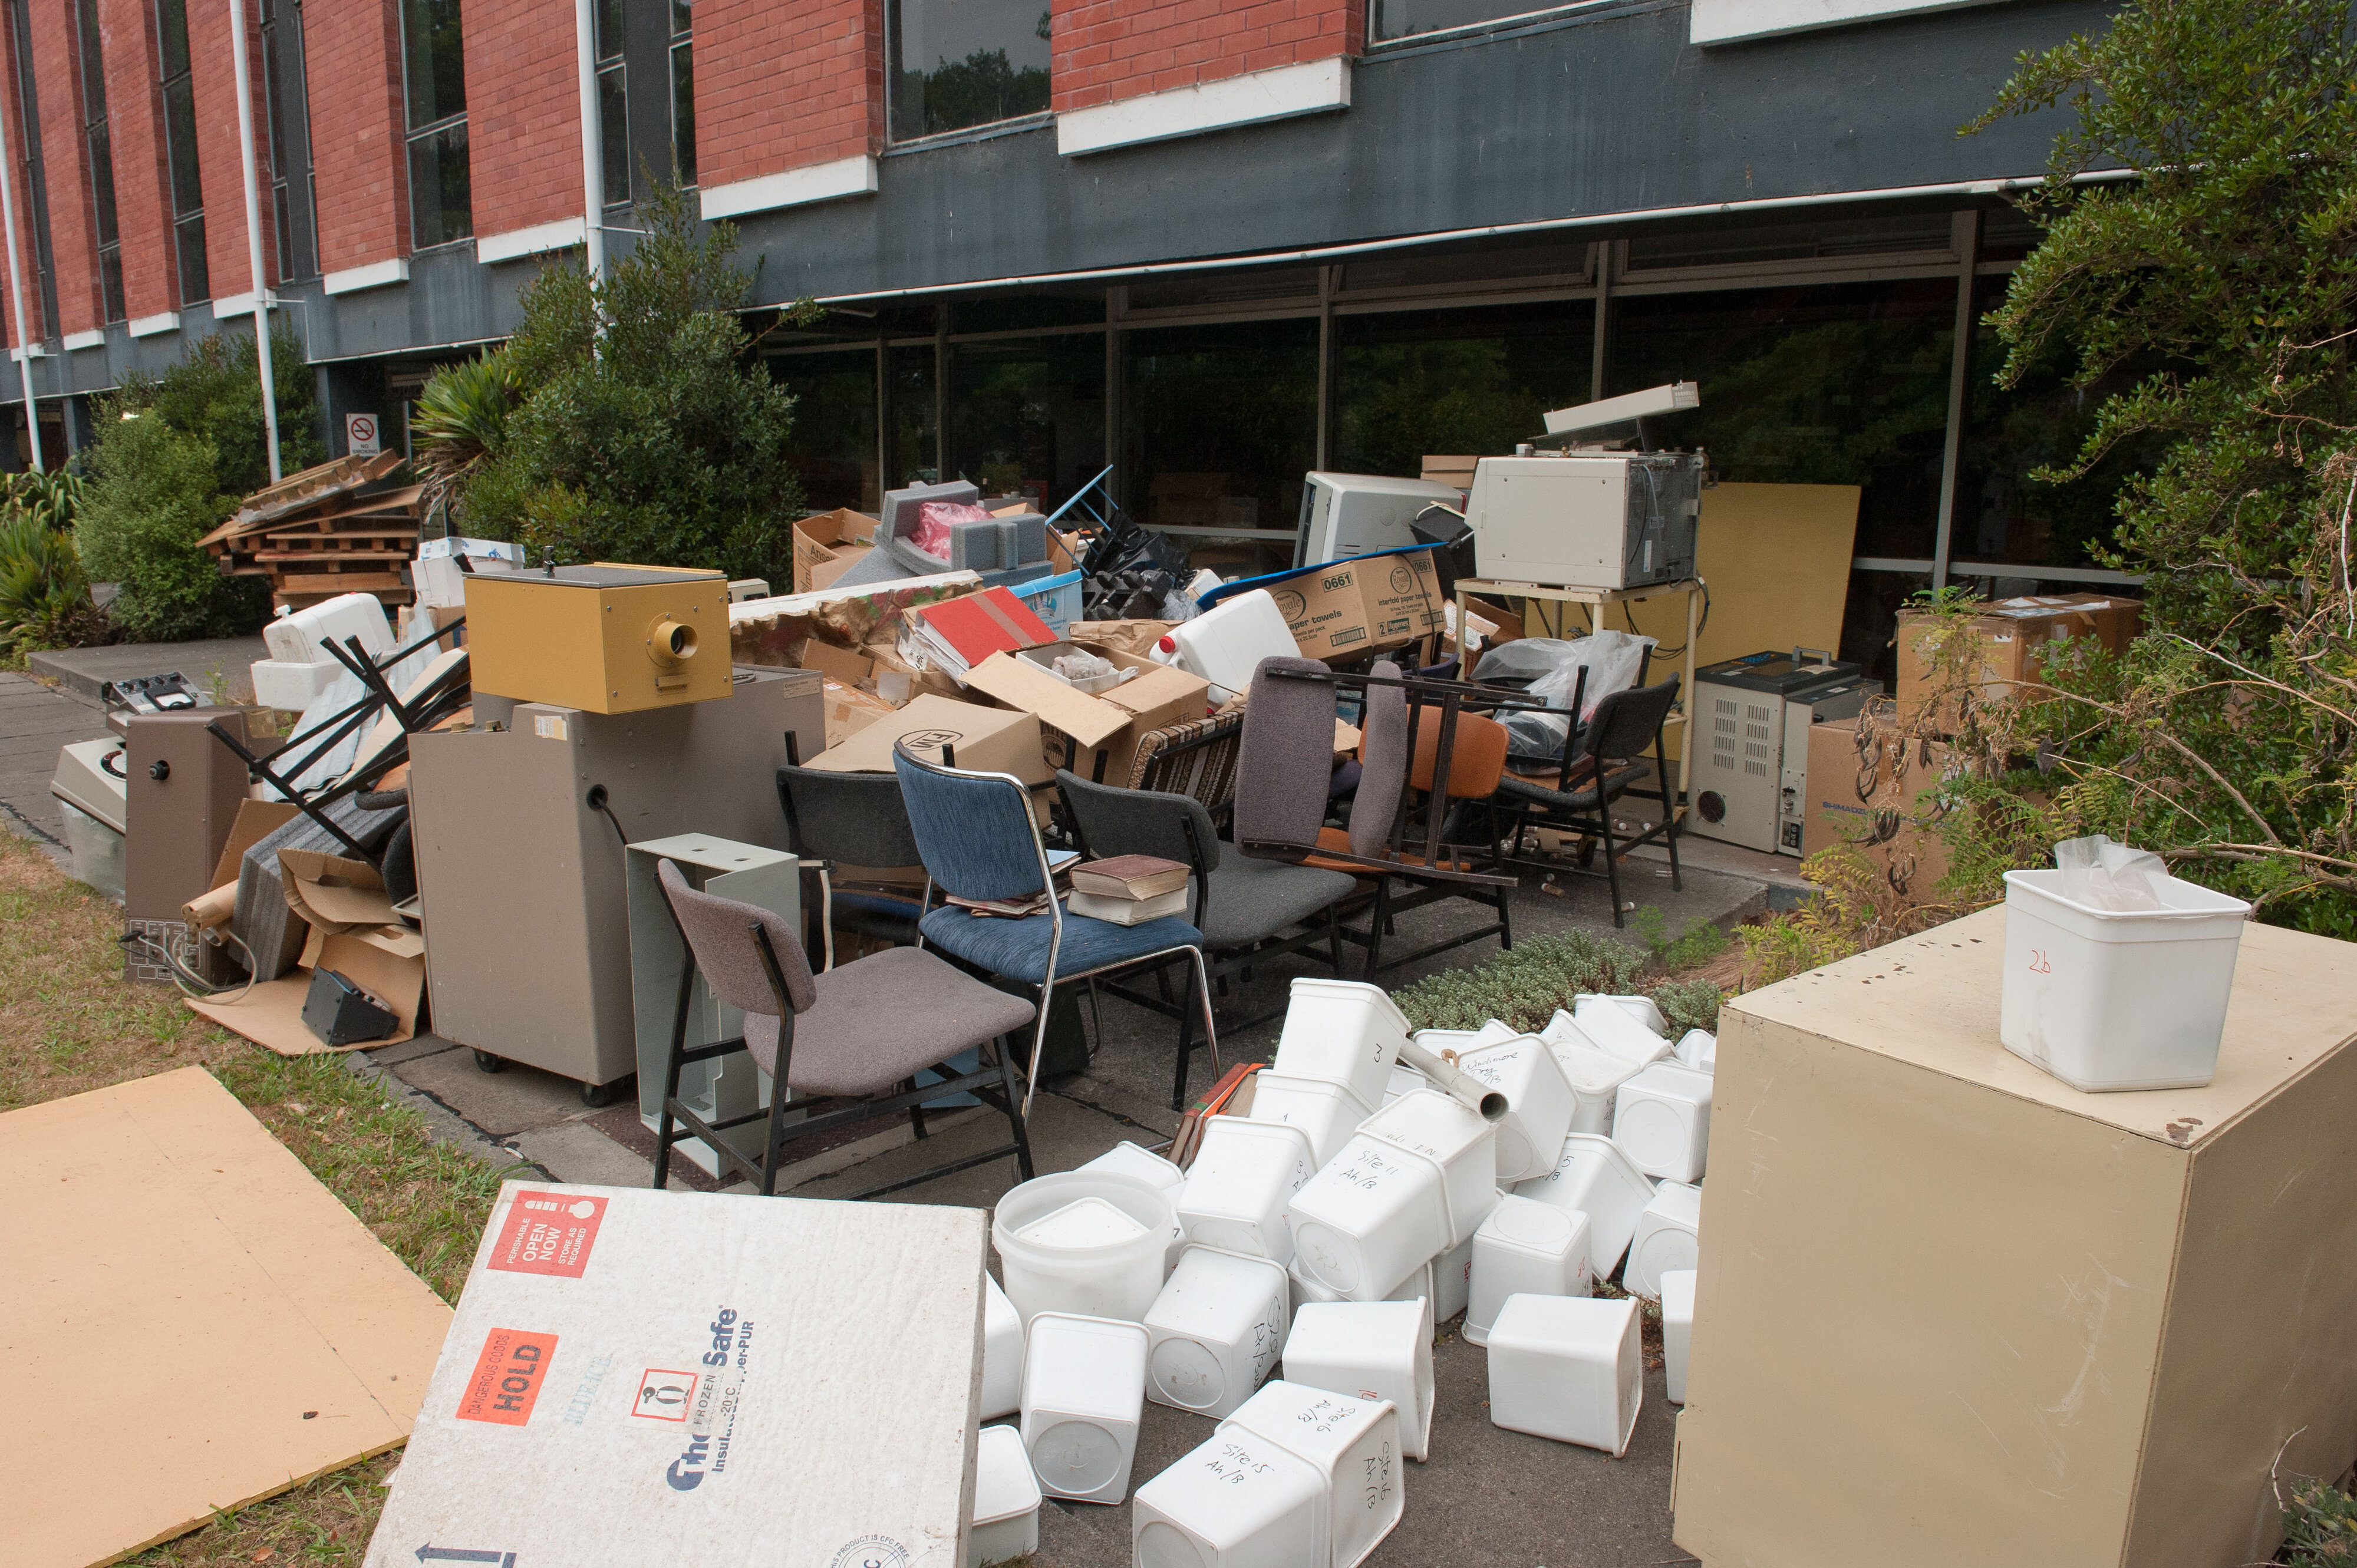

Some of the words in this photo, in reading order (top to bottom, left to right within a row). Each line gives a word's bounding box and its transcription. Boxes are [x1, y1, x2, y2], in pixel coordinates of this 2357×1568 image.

[810, 545, 835, 563] Anse
[1415, 560, 1432, 572] 0661
[1324, 573, 1351, 590] 0661
[1277, 596, 1301, 612] oyale
[1377, 596, 1399, 606] interfold
[1400, 594, 1414, 604] paper
[1415, 591, 1432, 600] towls
[1287, 619, 1309, 630] aper
[1311, 610, 1343, 624] towels
[1379, 624, 1385, 635] 2
[506, 1217, 530, 1264] PERISHABLE
[522, 1223, 548, 1262] OPEN
[538, 1227, 562, 1261] NOW
[558, 1239, 573, 1265] STORE
[569, 1227, 578, 1238] AS
[568, 1227, 587, 1266] REQUIRED
[467, 1364, 498, 1415] DANGEROUS
[489, 1334, 510, 1364] GOODS
[493, 1345, 541, 1412] HOLD
[693, 1374, 716, 1425] FROZEN
[1222, 1444, 1250, 1465] Site
[836, 1534, 869, 1557] PRODUCT
[880, 1535, 895, 1544] CFC
[894, 1541, 910, 1559] FREE
